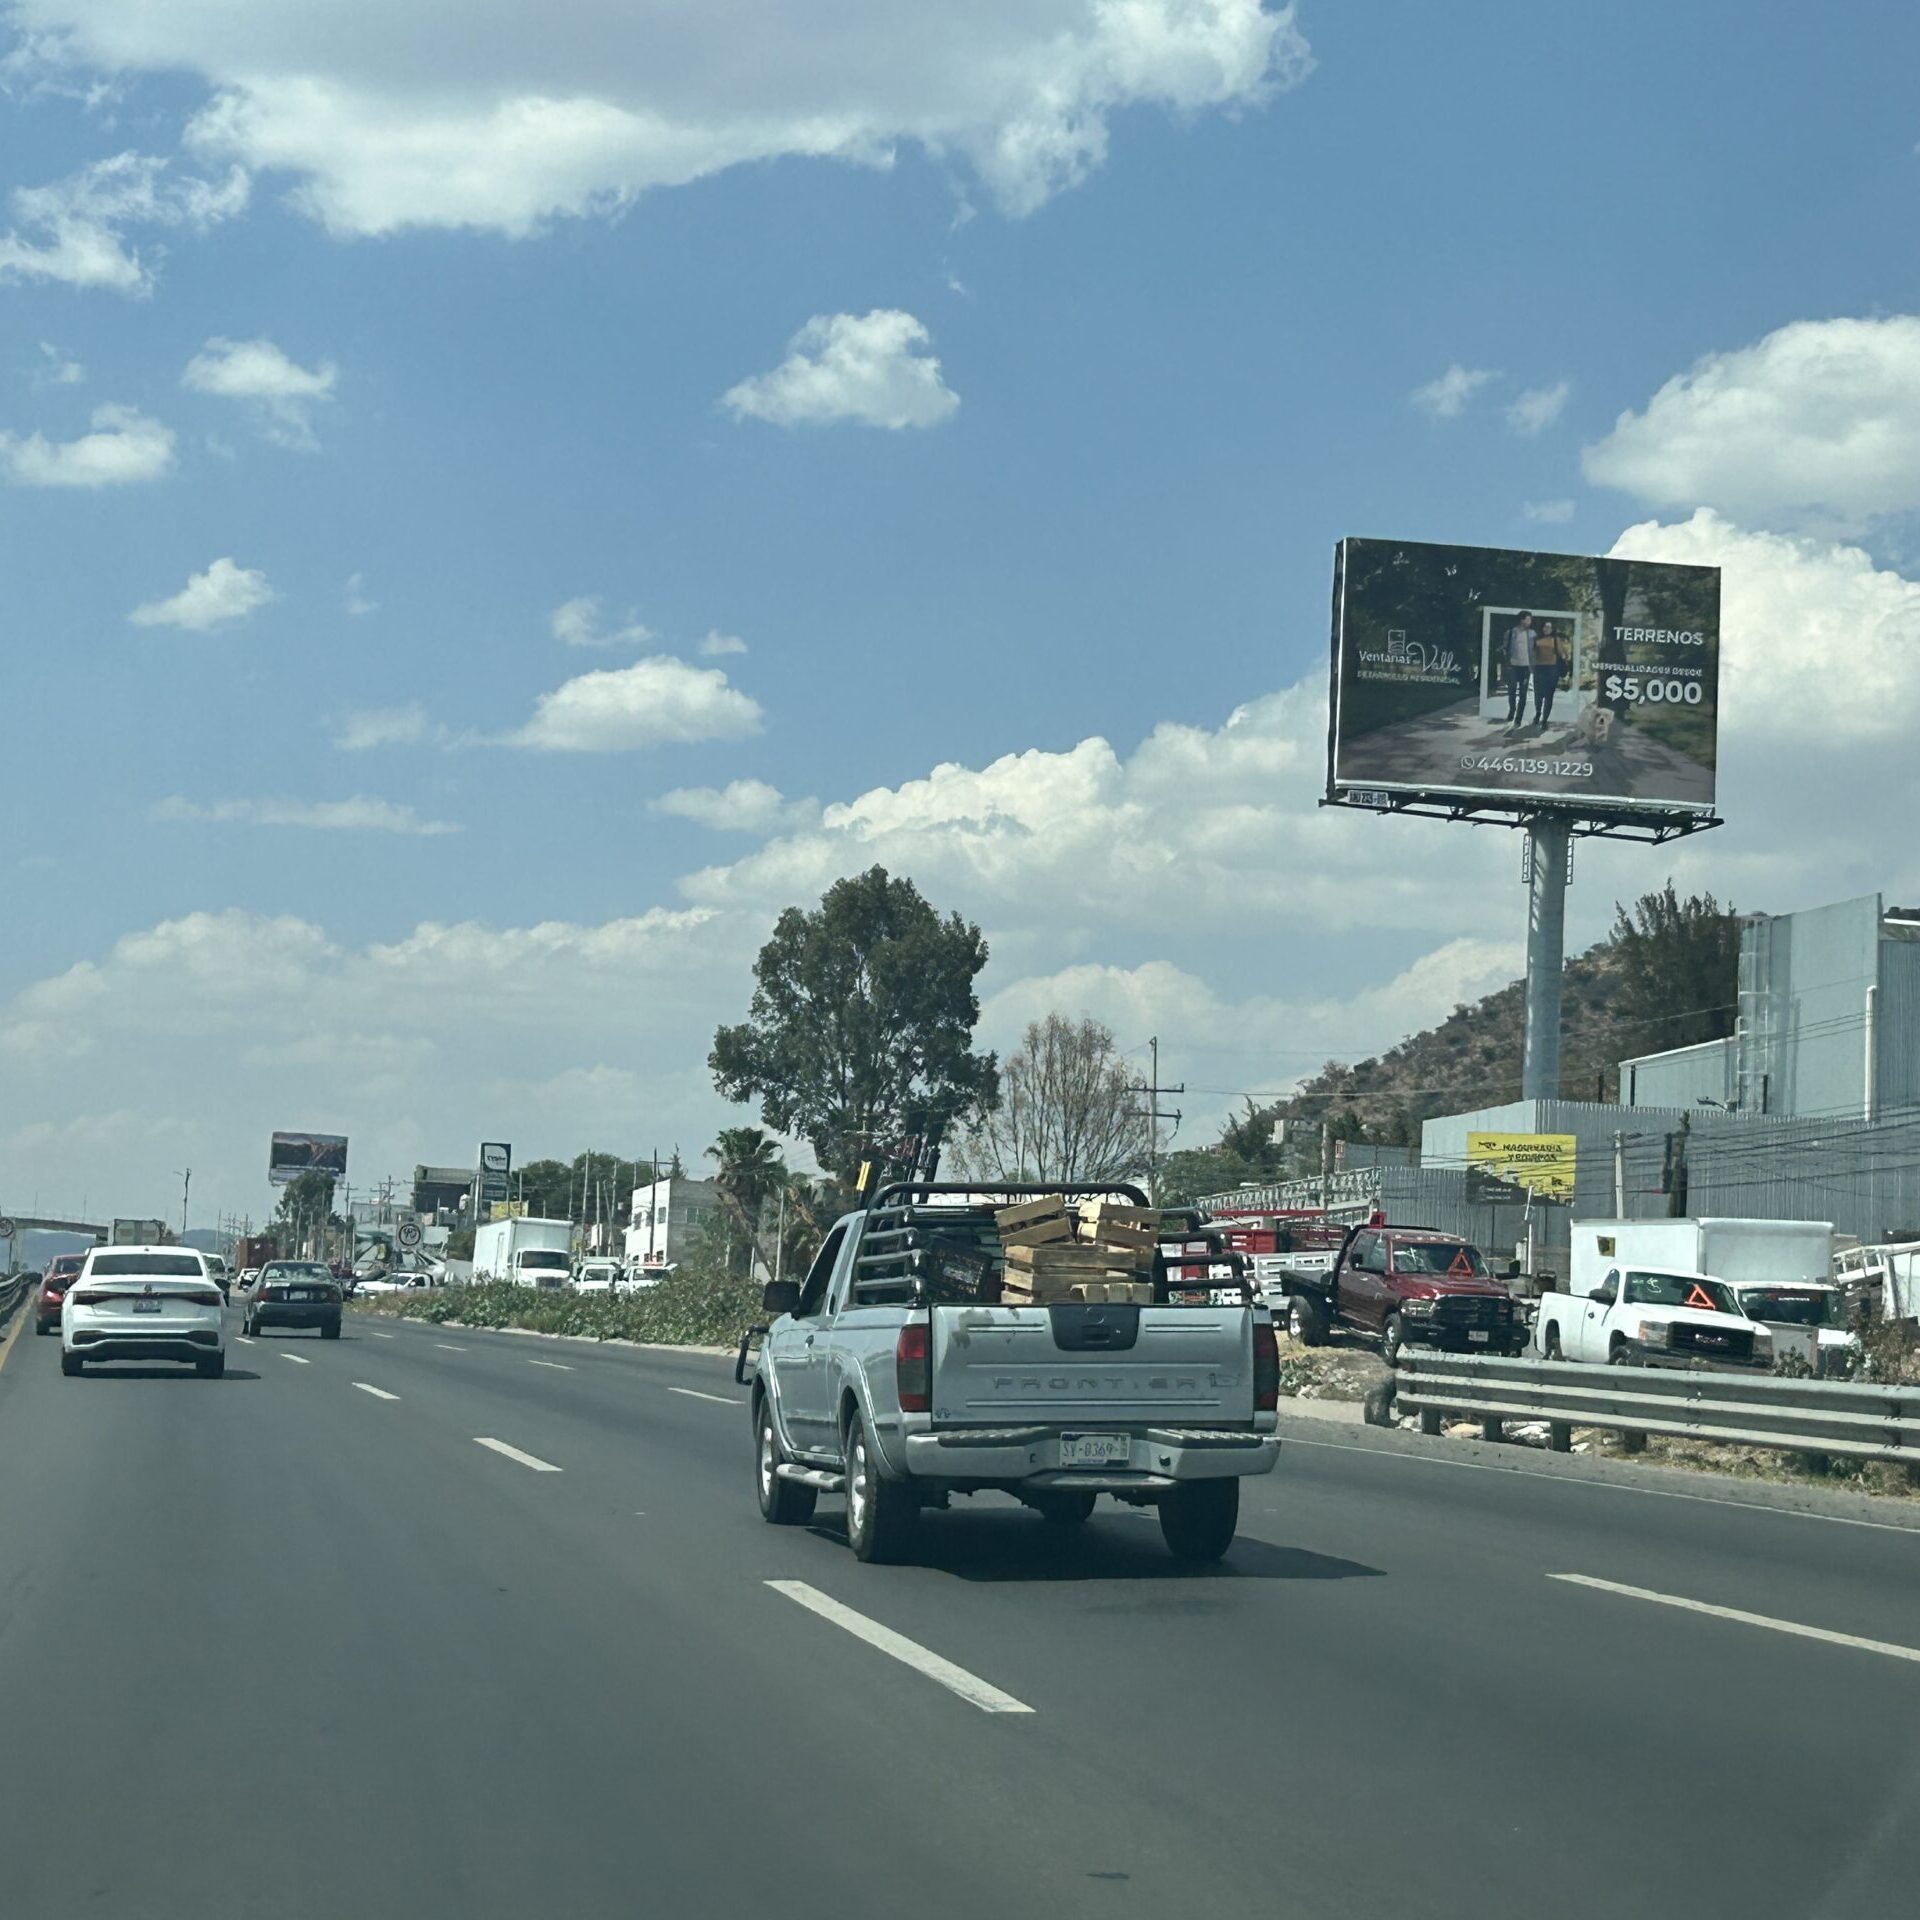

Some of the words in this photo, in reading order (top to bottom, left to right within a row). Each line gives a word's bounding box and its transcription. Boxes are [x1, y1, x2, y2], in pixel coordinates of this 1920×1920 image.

[1613, 626, 1704, 646] TERRENOS
[1359, 650, 1410, 664] Ventanas
[1605, 674, 1703, 705] $5,000
[1476, 757, 1593, 777] 446.139.1229
[993, 1376, 1197, 1391] FRONTIER
